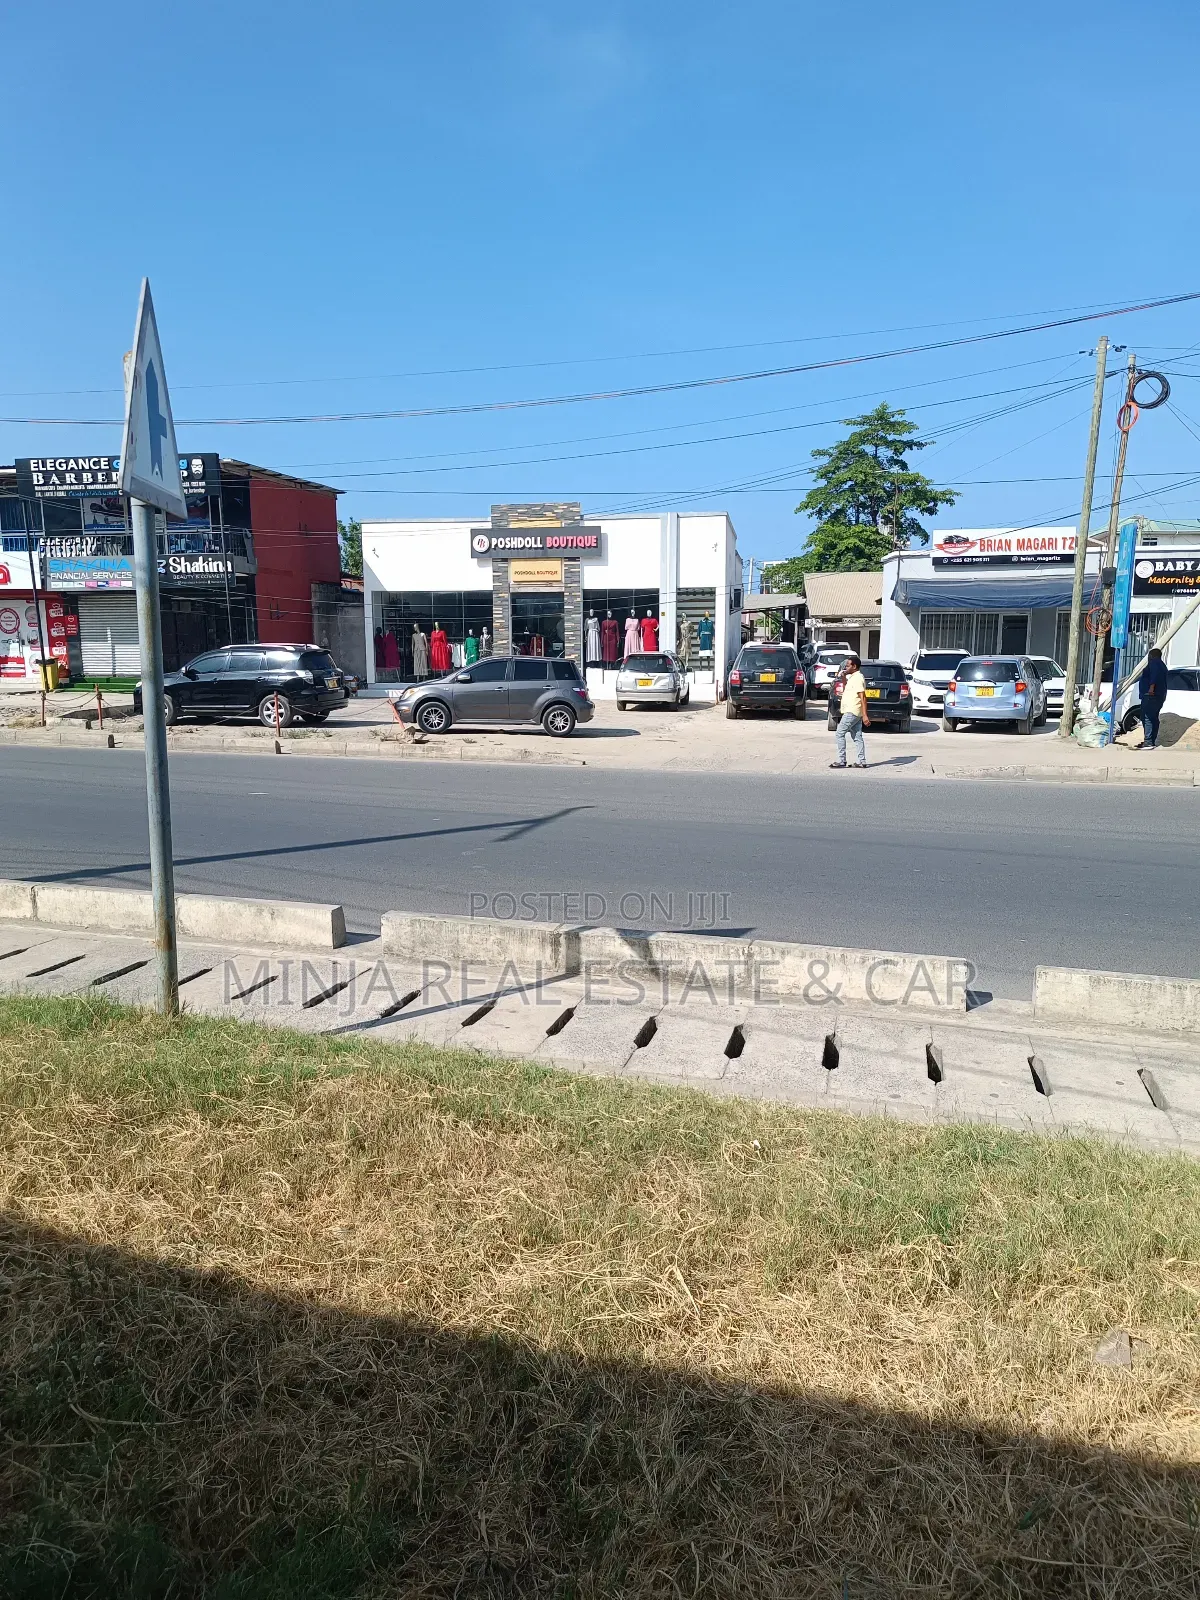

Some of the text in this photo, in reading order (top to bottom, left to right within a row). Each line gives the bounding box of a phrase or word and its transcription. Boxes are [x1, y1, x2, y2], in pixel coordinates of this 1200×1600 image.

[30, 458, 109, 471] ELEGANCE
[491, 535, 597, 549] POSHDOLL BOUTIQUE
[979, 538, 1012, 553] BRIAN
[1016, 537, 1058, 551] MAGARI
[1062, 536, 1075, 550] TZ
[49, 558, 132, 572] SHAKINA
[169, 555, 233, 574] Shakina
[1155, 561, 1195, 572] BABY
[92, 571, 133, 579] SERVICES
[1148, 576, 1195, 586] Maternity
